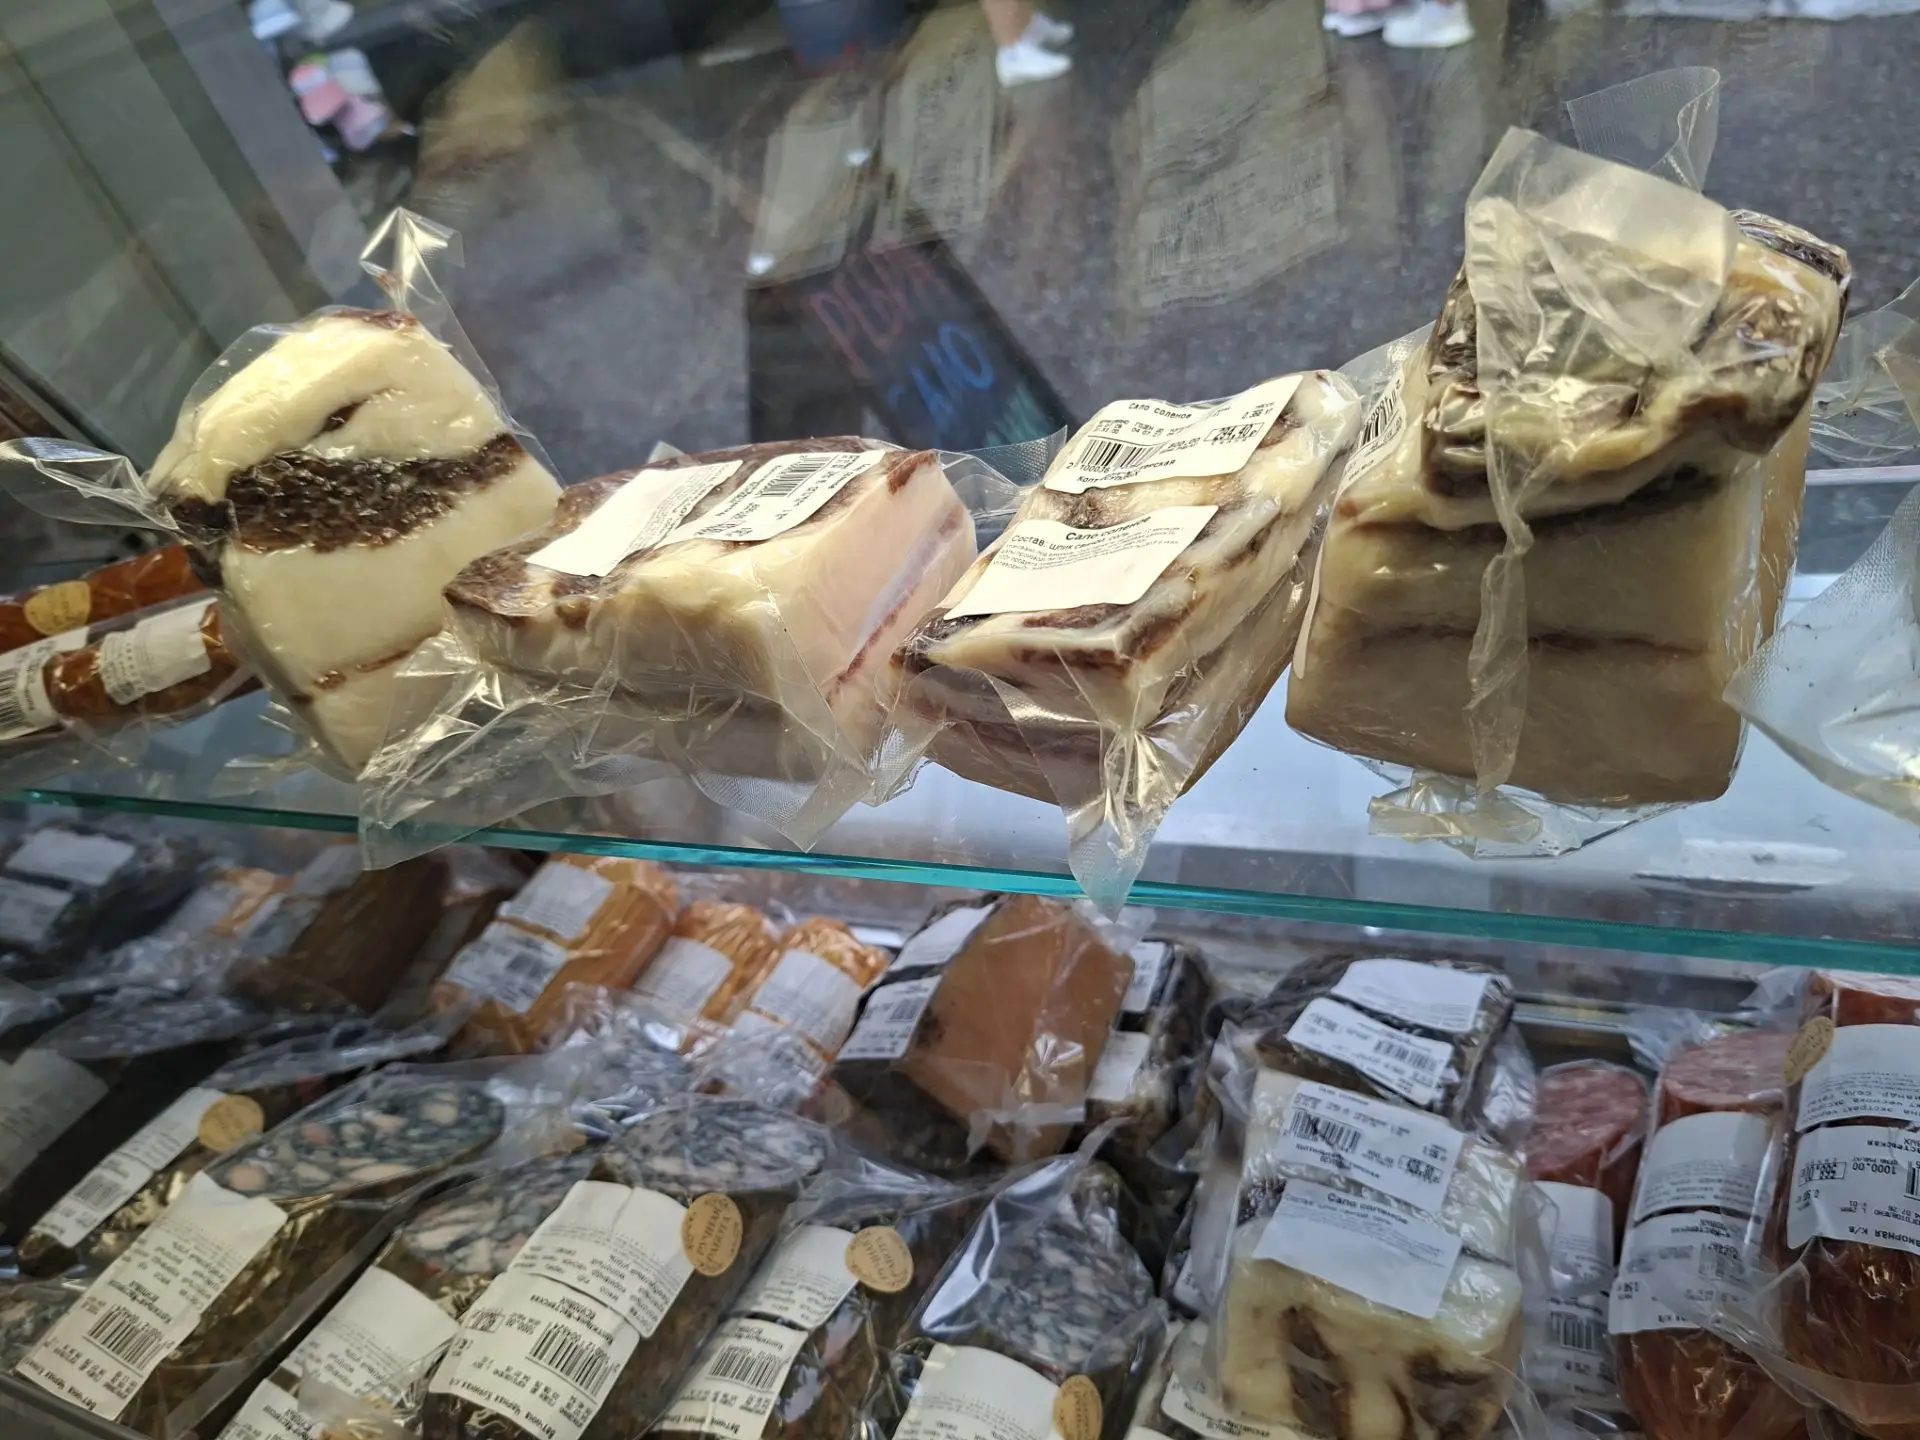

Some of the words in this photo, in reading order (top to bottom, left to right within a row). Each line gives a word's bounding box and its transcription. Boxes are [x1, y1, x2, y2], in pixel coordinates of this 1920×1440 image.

[1128, 402, 1151, 411] Сало
[1153, 407, 1192, 419] соленое
[1011, 534, 1048, 547] Состав:
[1065, 530, 1099, 541] Сало
[1852, 1161, 1897, 1175] 1000.00
[1327, 1191, 1358, 1208] Сало
